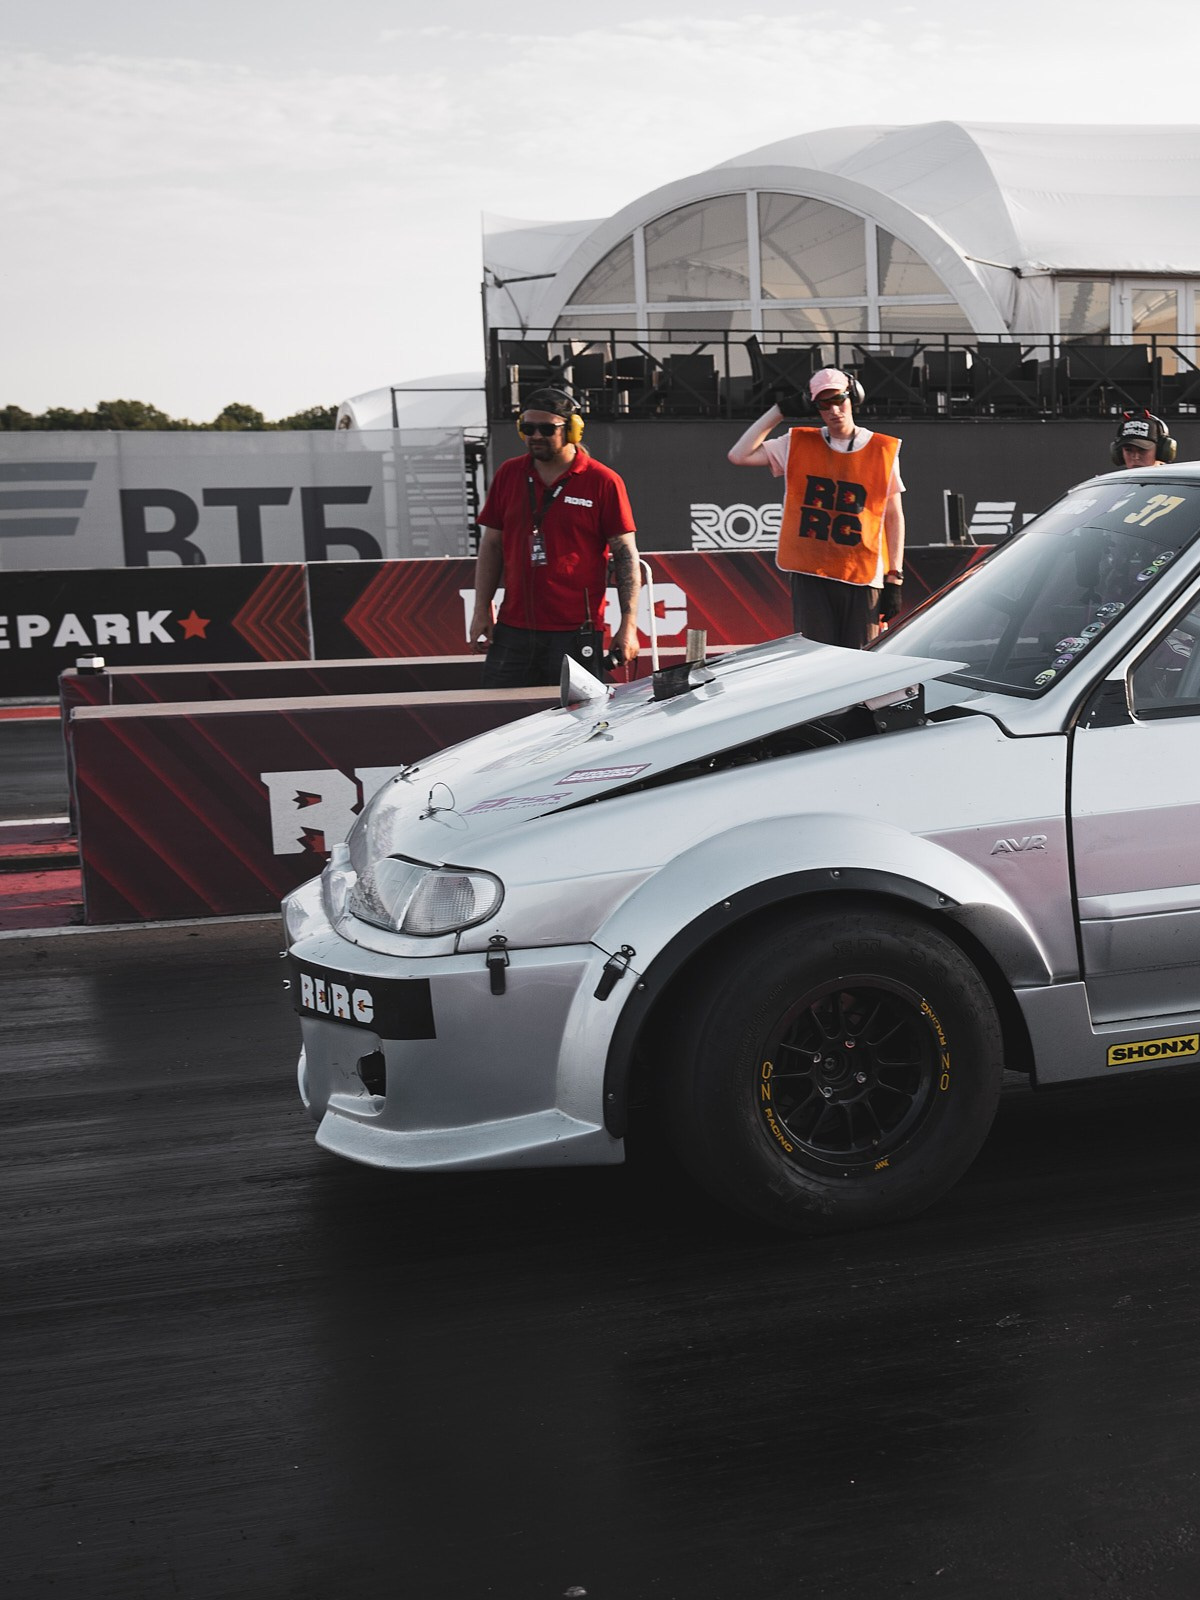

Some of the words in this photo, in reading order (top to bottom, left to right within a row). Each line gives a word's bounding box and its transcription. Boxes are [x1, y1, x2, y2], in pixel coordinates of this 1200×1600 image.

[564, 495, 593, 508] RDRC
[1124, 494, 1186, 527] 37
[990, 835, 1048, 855] AVR
[920, 1001, 947, 1046] RACING
[1112, 1039, 1196, 1061] SHONX
[765, 1107, 793, 1153] RACING
